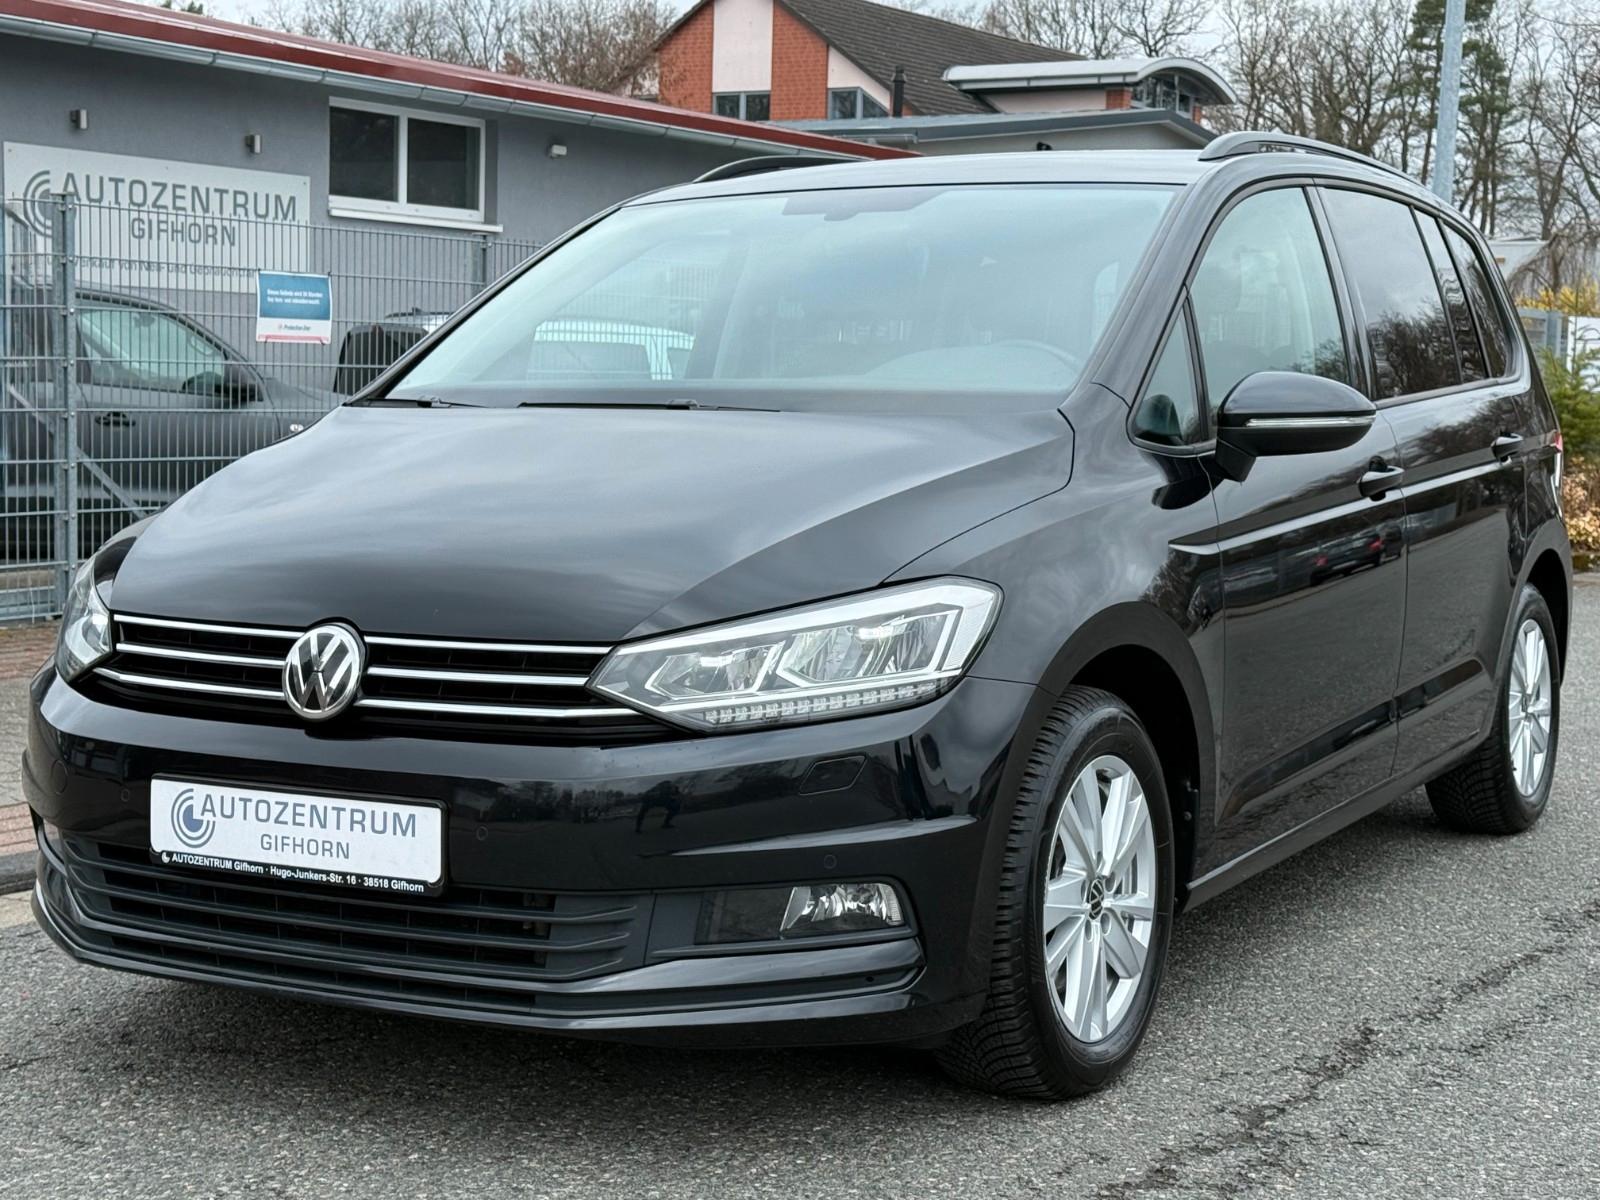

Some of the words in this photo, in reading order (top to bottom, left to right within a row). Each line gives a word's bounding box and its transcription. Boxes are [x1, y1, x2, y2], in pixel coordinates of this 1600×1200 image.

[62, 172, 297, 222] AUTOZENTRUM
[131, 217, 236, 247] GIFHORN
[285, 627, 360, 715] VW
[200, 793, 416, 838] AUTOZENTRUM
[260, 833, 350, 860] GIFHORN
[171, 853, 233, 869] AUTOZENTRUM
[233, 860, 264, 874] Gifhorn
[270, 865, 344, 884] Hugo-Junkers-Str.
[346, 875, 357, 885] 16
[363, 876, 389, 888] 38518
[390, 879, 425, 893] Gifhorn
